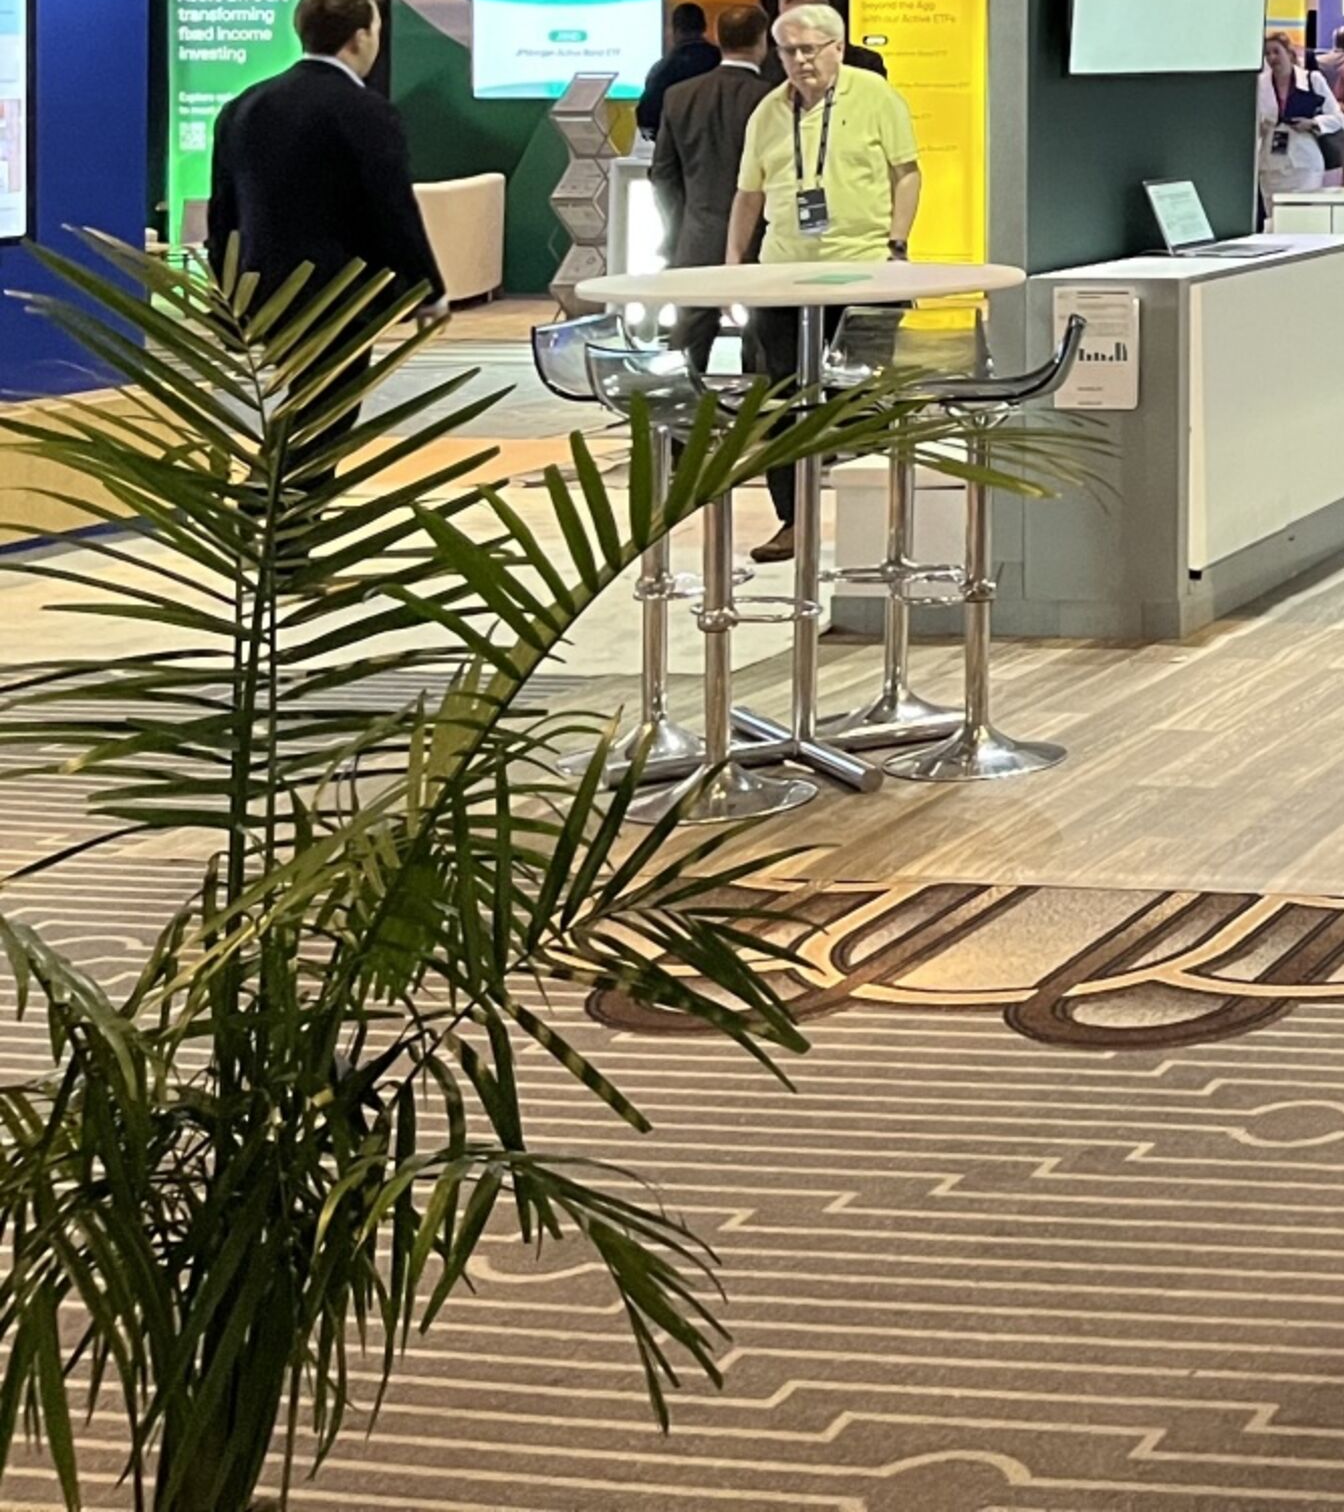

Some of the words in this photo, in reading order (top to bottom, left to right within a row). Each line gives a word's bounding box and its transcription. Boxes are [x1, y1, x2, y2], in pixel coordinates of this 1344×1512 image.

[178, 7, 275, 24] transforming
[178, 26, 214, 41] fixed
[216, 26, 273, 41] income
[179, 46, 247, 64] investing
